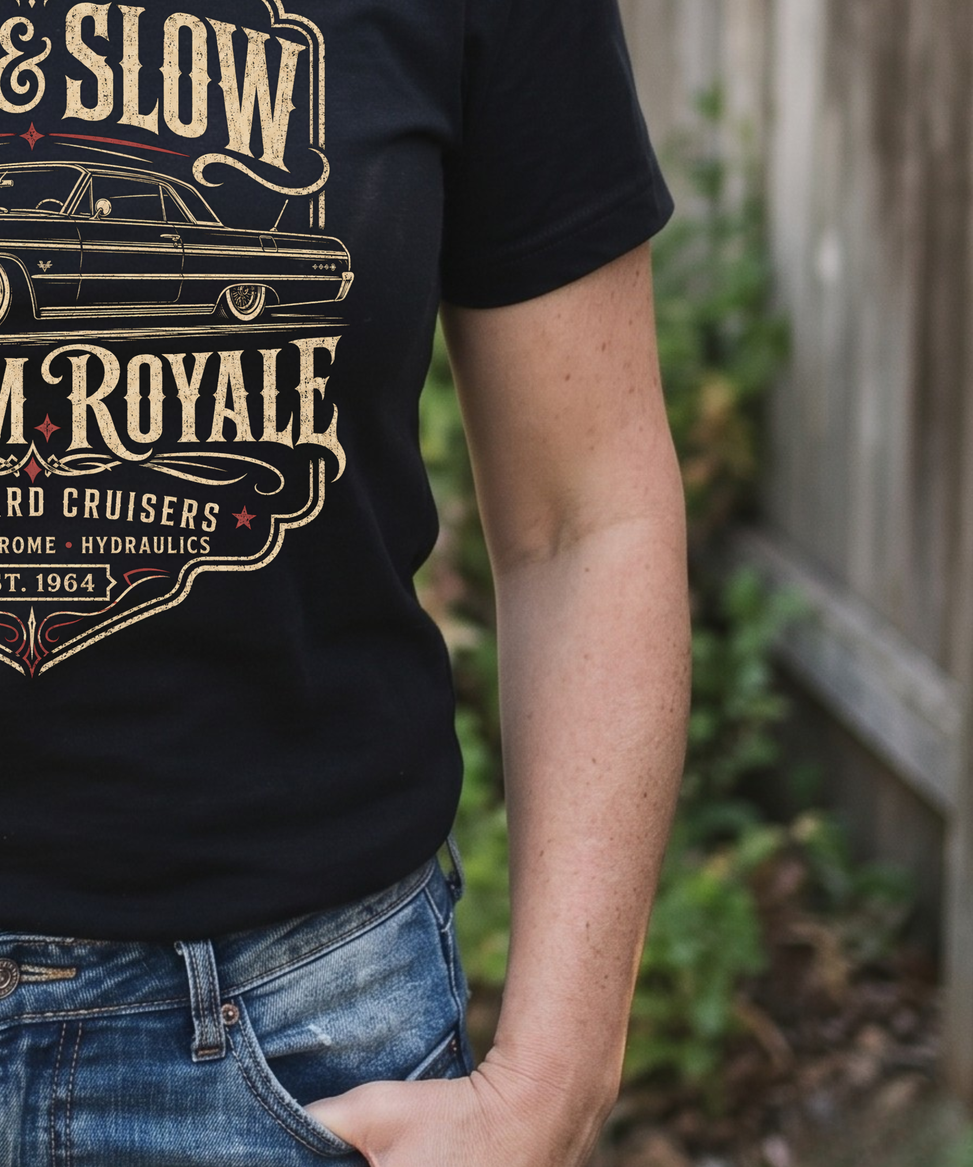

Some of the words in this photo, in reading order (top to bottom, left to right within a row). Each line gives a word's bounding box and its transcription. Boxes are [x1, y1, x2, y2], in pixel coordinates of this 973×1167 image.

[61, 1, 308, 175] SLOW
[40, 334, 347, 483] ROYALE
[62, 486, 220, 532] CRUISERS
[81, 536, 212, 555] HYDRAULICS
[35, 572, 96, 593] 1964
